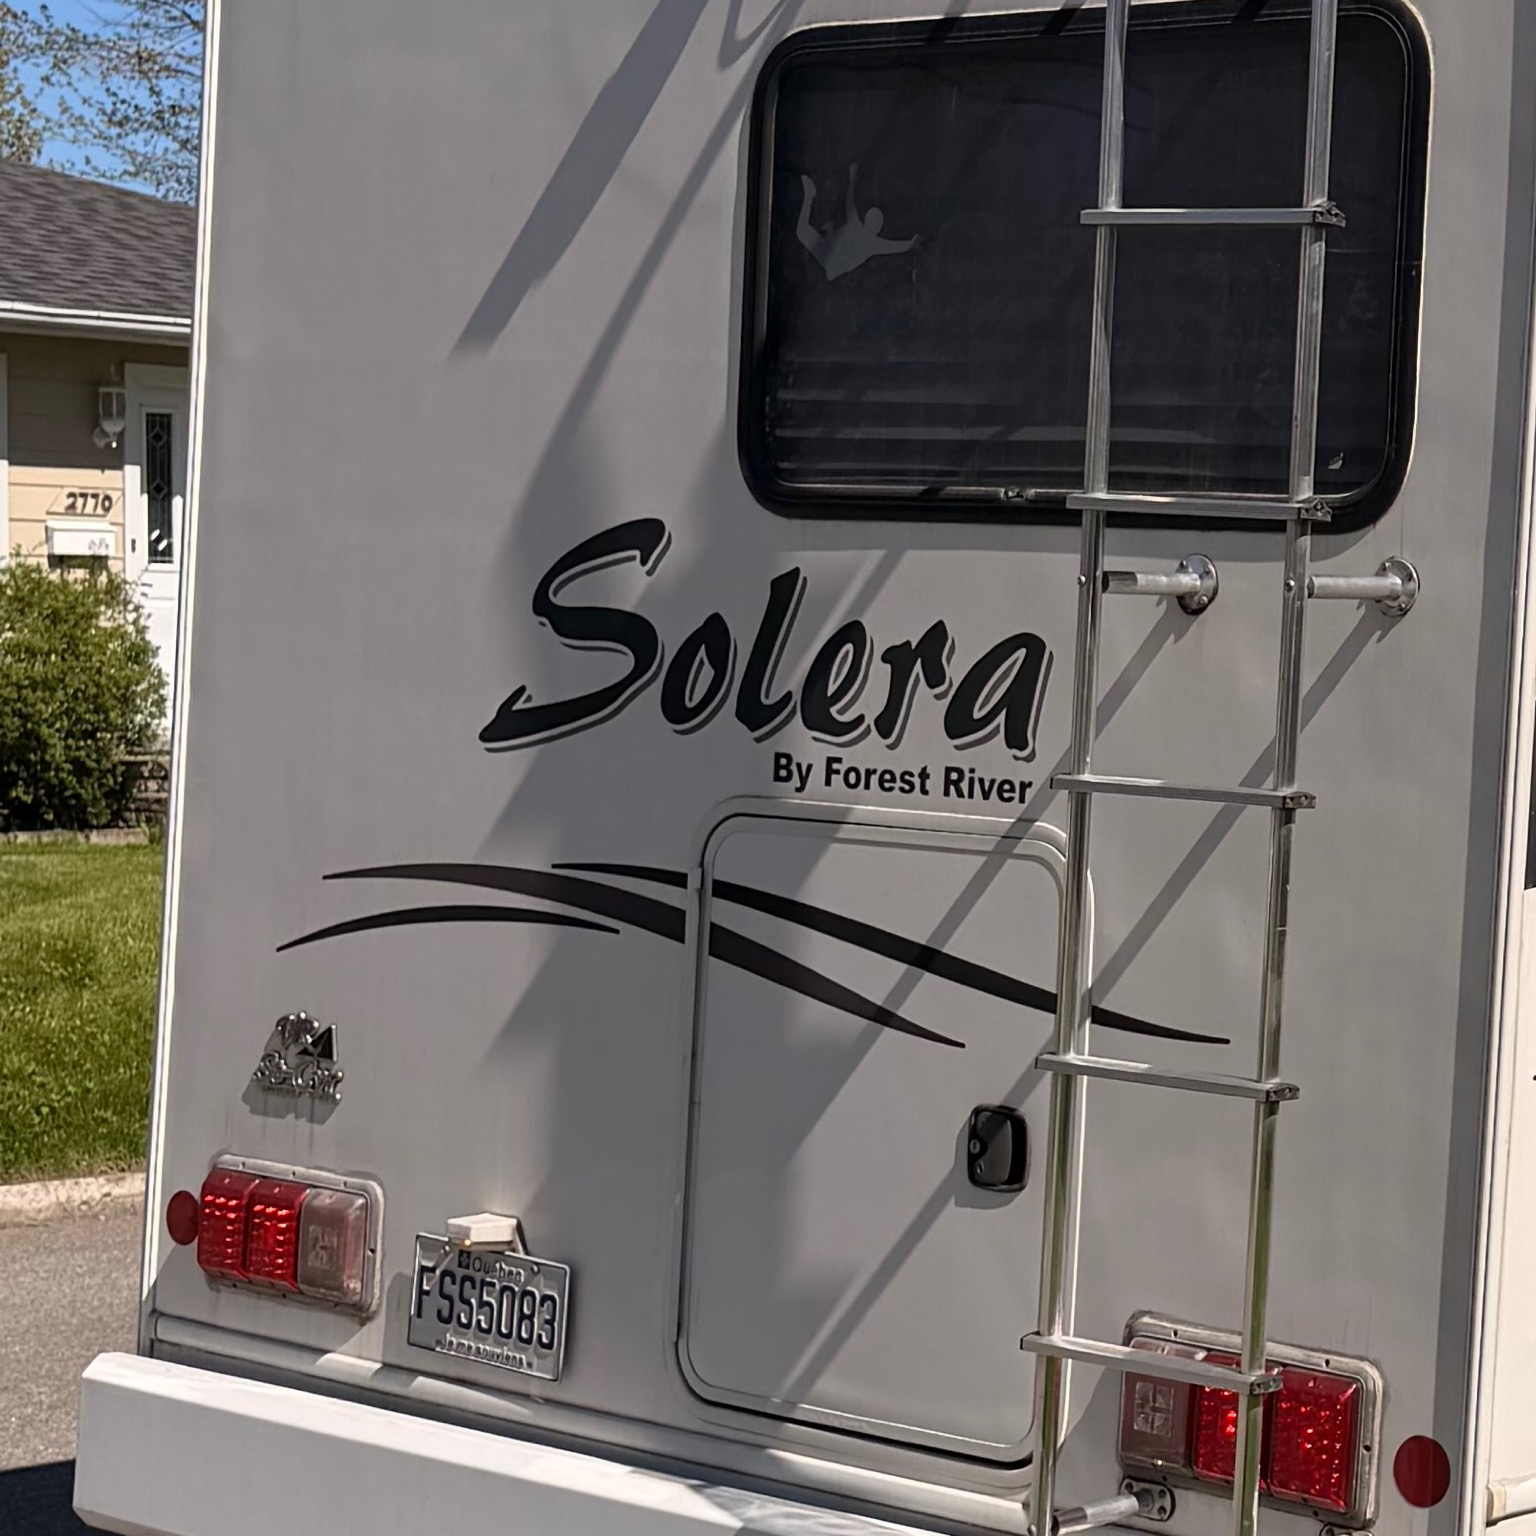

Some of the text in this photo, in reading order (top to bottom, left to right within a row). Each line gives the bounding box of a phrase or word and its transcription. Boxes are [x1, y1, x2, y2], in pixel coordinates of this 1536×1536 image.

[64, 491, 113, 515] 2770
[478, 517, 1054, 762] Solera
[772, 751, 1033, 804] By Forest River
[415, 1264, 560, 1351] FSS5083
